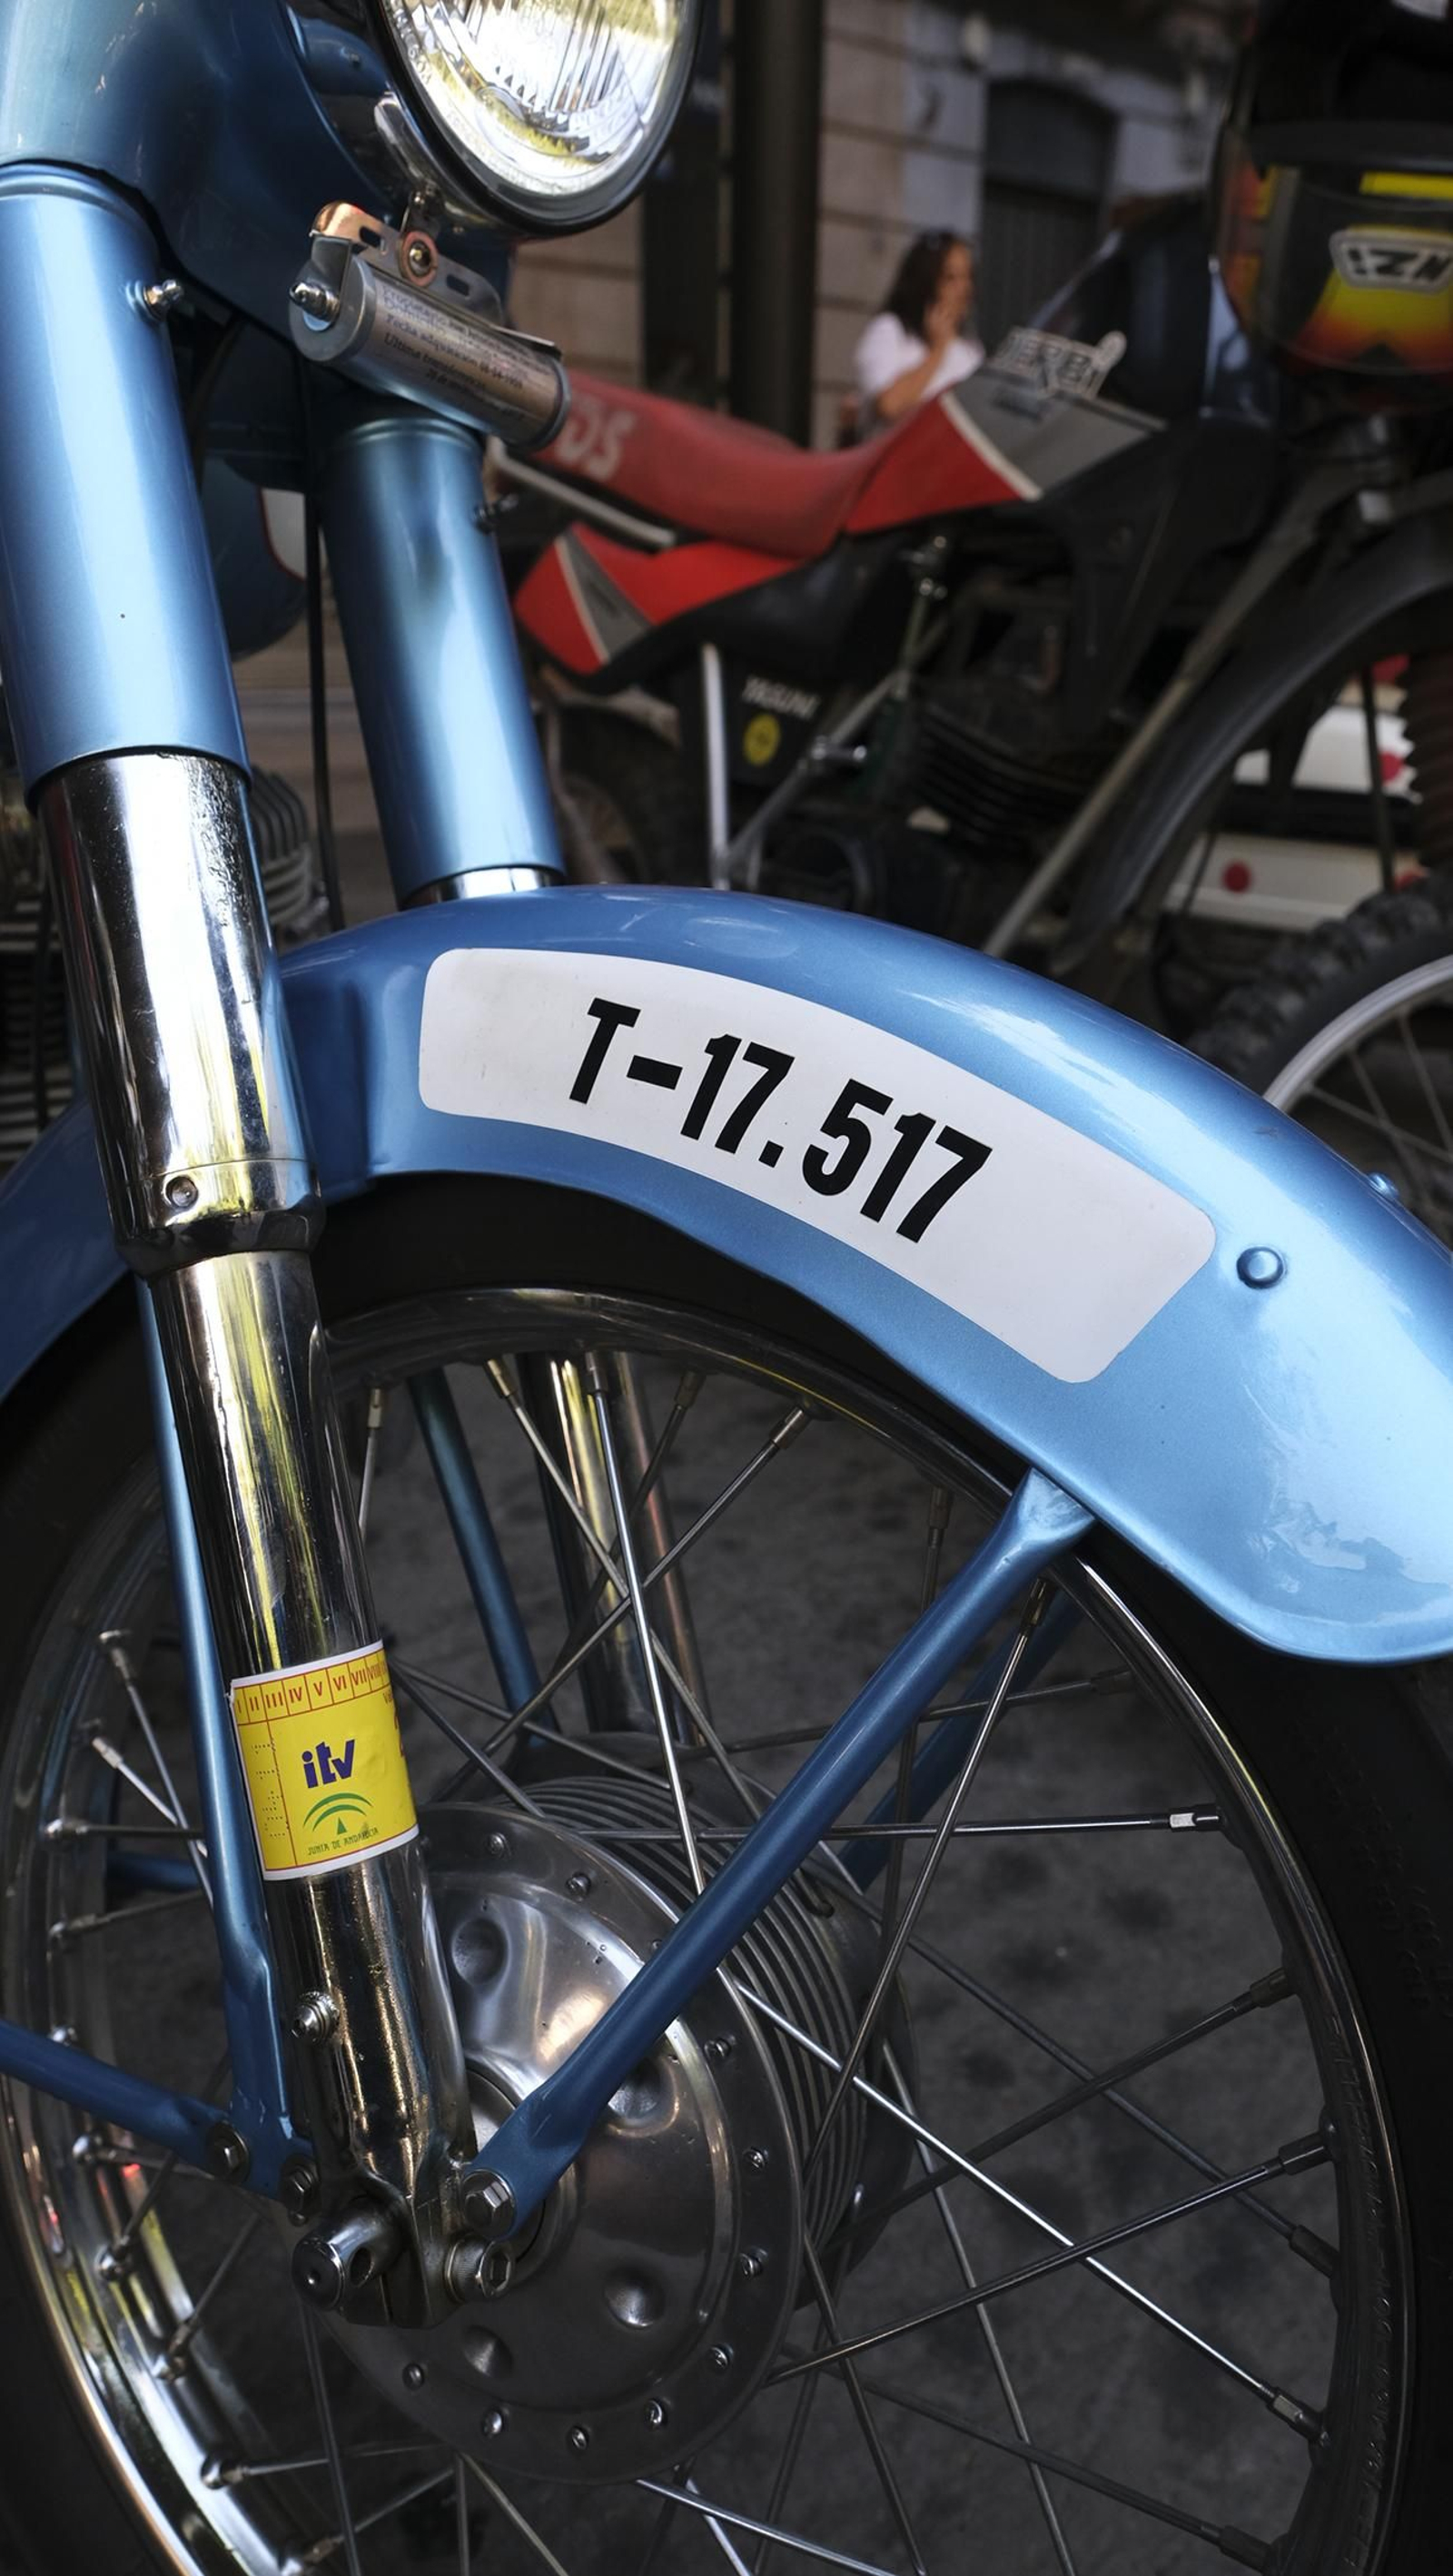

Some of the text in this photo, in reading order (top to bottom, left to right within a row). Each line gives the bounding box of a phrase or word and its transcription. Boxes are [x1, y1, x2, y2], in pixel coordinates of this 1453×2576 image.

[569, 998, 993, 1243] T-17.517
[249, 1696, 260, 1712] II
[265, 1692, 283, 1709] III
[289, 1686, 302, 1703] IV
[313, 1681, 322, 1696] V
[333, 1675, 347, 1691] VI
[351, 1668, 367, 1686] VII
[301, 1739, 355, 1789] itv
[307, 1843, 331, 1856] JUNTA
[332, 1840, 341, 1849] DE
